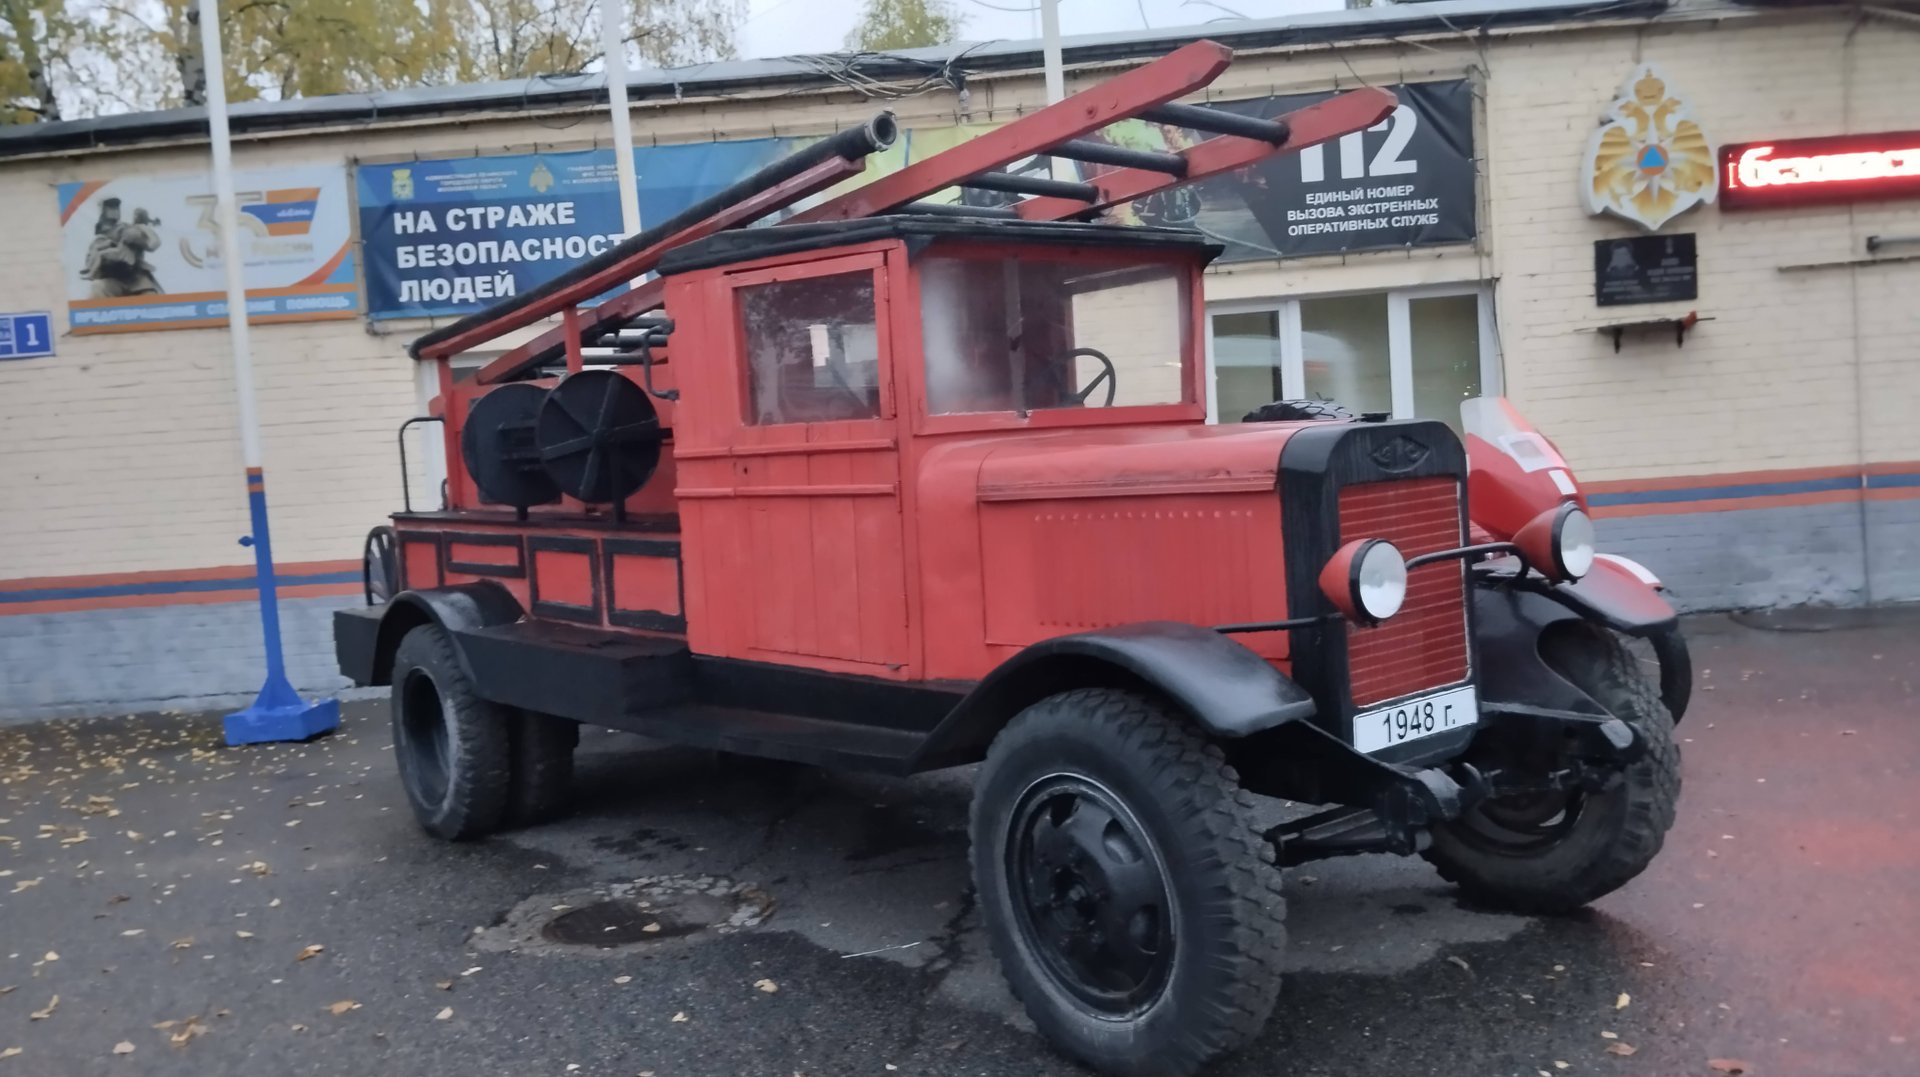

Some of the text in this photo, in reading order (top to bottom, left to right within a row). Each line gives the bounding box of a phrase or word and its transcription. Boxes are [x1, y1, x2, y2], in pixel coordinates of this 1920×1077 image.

[1305, 184, 1415, 205] ЕДИНЫЙ НОМЕР
[393, 202, 576, 235] НА СТРАЖЕ
[1287, 198, 1439, 221] ВЫЗОВА ЭКСТРЕННЫХ
[1287, 213, 1439, 236] ОПЕРАТИВНЫХ СЛУЖБ
[396, 233, 626, 269] БЕЗОПАСНОСТ
[398, 270, 516, 305] ЛЮДЕЙ
[26, 323, 40, 346] 1
[1382, 702, 1456, 743] 1948 г.
